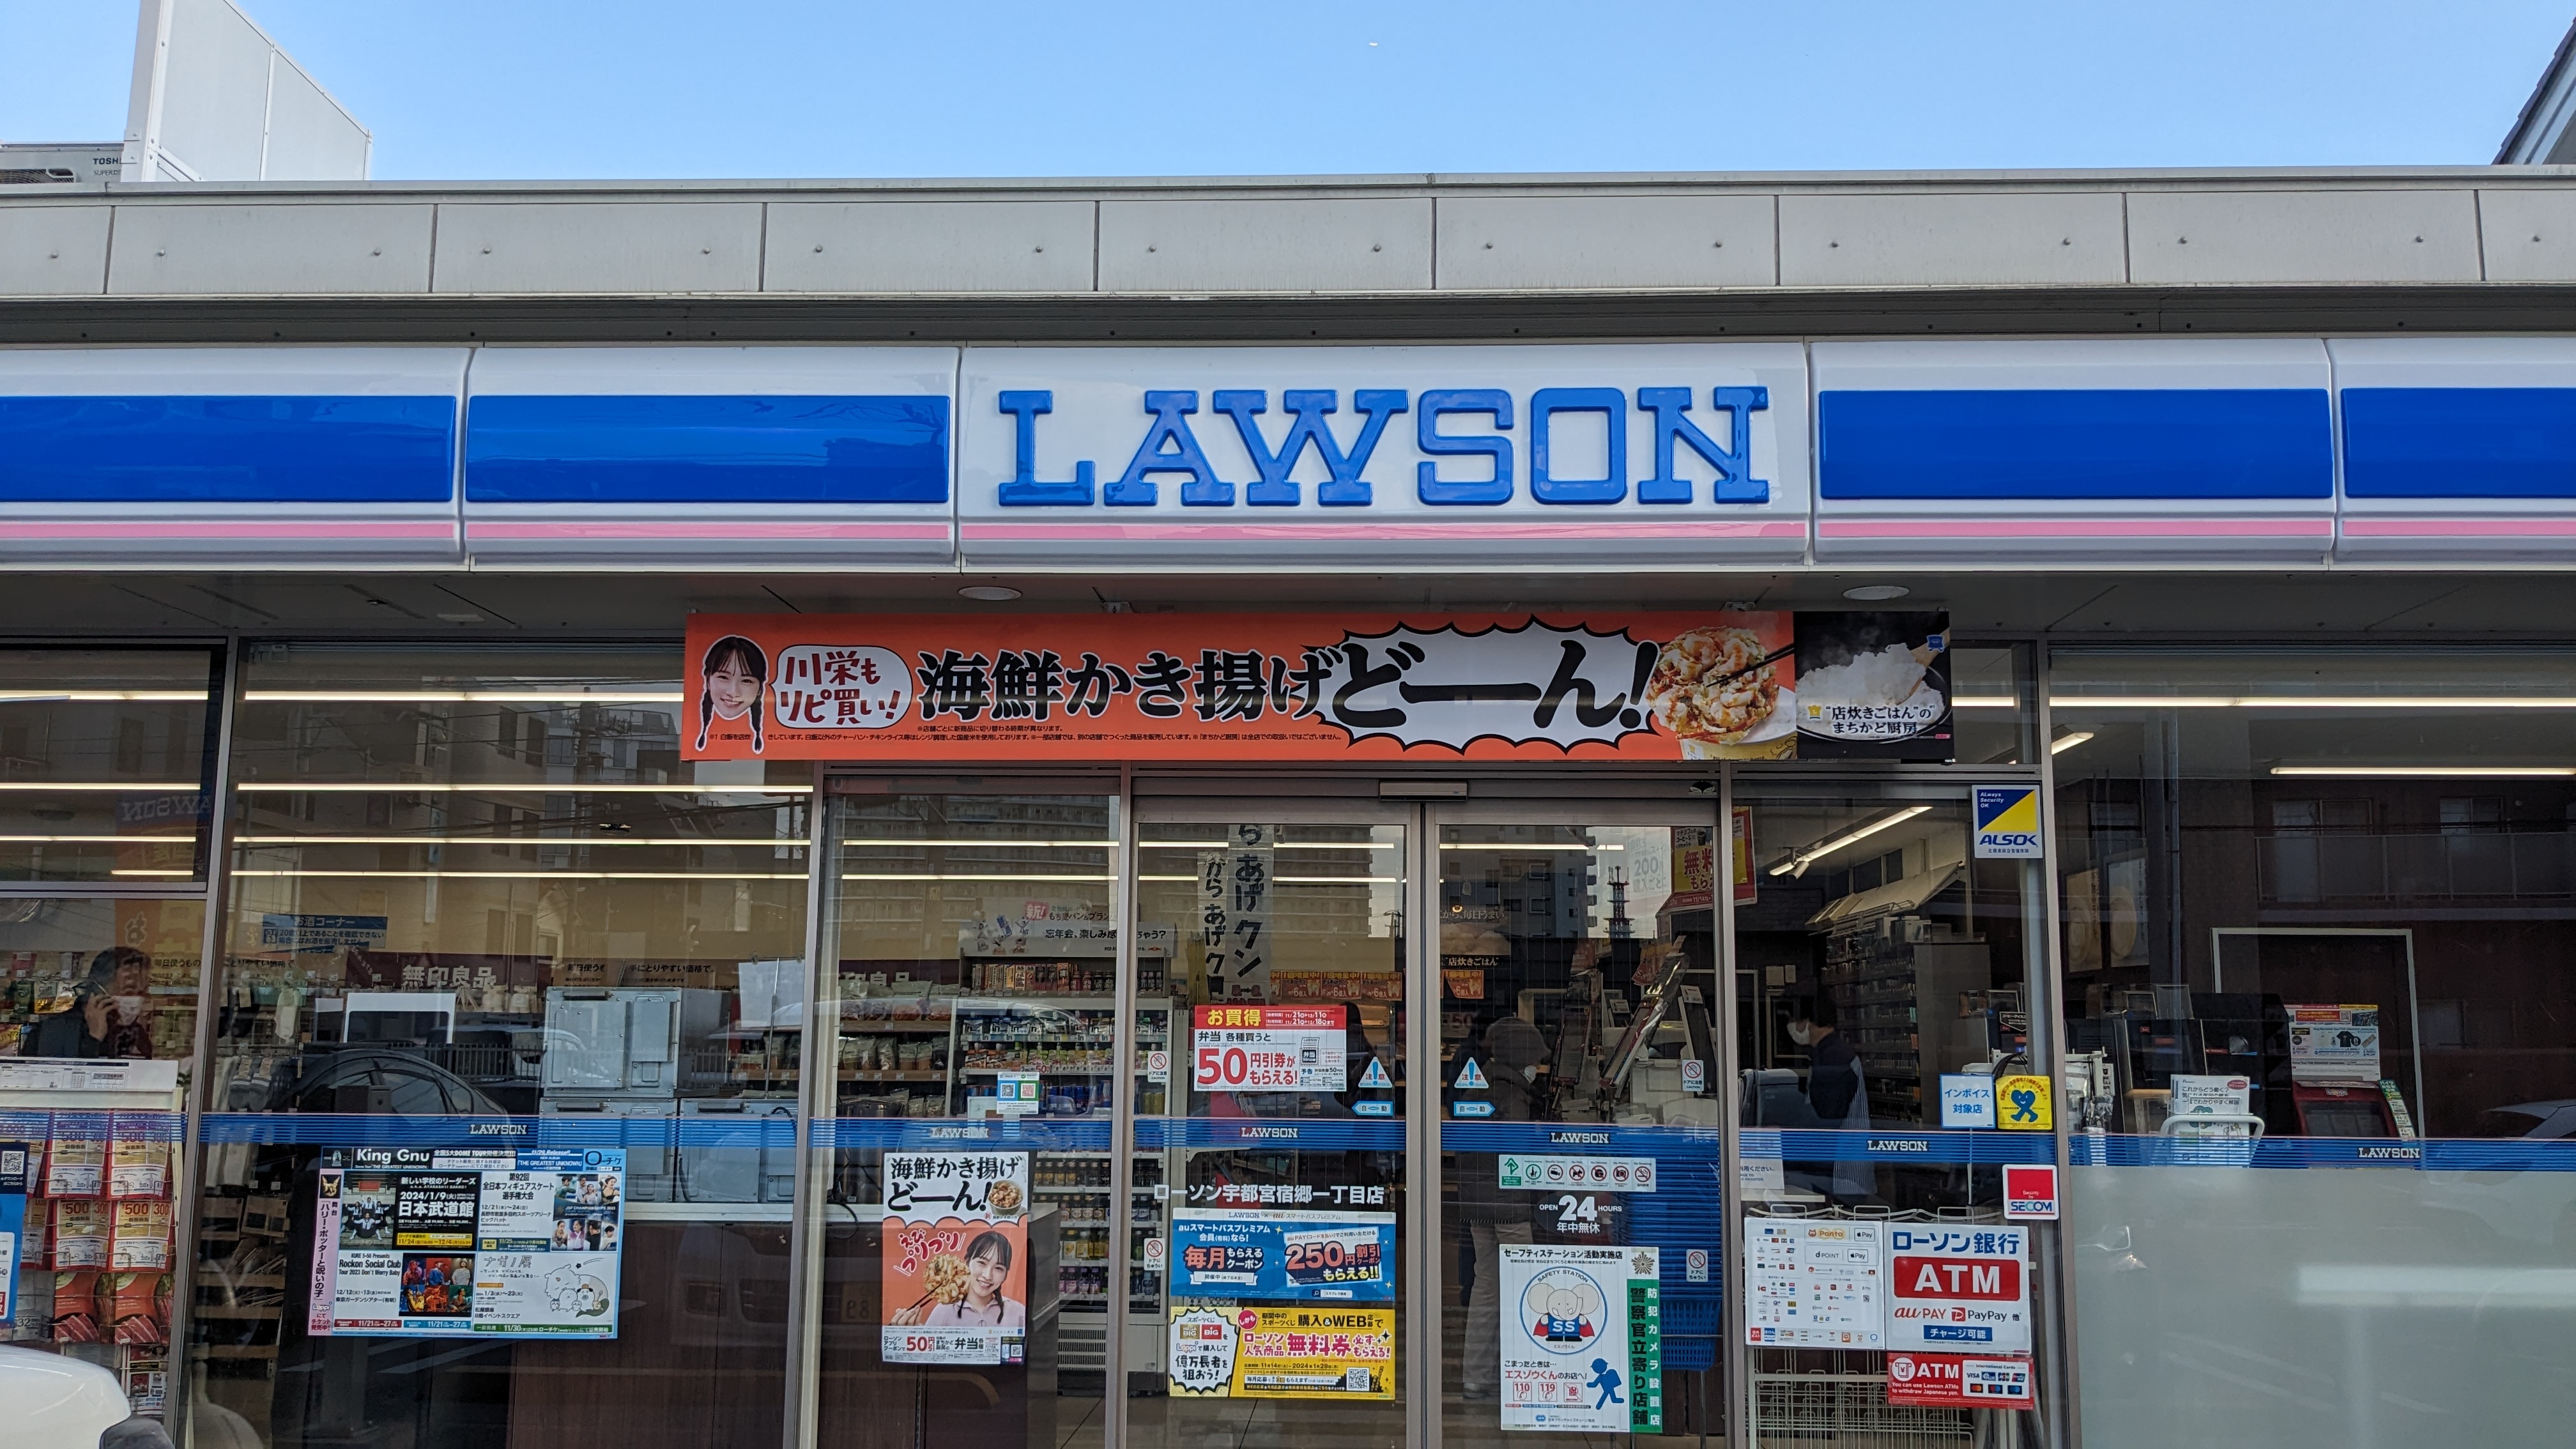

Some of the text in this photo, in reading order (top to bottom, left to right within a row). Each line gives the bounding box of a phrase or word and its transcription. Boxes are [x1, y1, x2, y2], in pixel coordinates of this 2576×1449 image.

[999, 387, 1770, 506] LAWSON
[785, 650, 881, 686] 川栄も
[916, 648, 1342, 723] 海鮮かき揚げ
[779, 687, 900, 725] リピ買い!
[1832, 721, 1917, 734] まちかど厨房
[1979, 834, 2038, 846] ALSOK
[295, 916, 355, 926] お酒コーナー
[402, 964, 496, 988] 無印良品
[1207, 1009, 1261, 1027] お買得
[1198, 1031, 1271, 1042] 弁当 各種買うと
[1197, 1047, 1248, 1085] 50
[1250, 1053, 1296, 1068] 円引券が
[1250, 1070, 1298, 1085] もらえる!
[1944, 1088, 1990, 1098] インボイス
[1952, 1103, 1982, 1114] 対象店
[470, 1124, 528, 1135] LAWSON
[931, 1128, 989, 1138] LAWSON
[1241, 1128, 1299, 1138] LAWSON
[1551, 1132, 1610, 1144] LAWSON
[1867, 1140, 1928, 1151] LAWSON
[356, 1149, 430, 1164] King Gnu
[2358, 1147, 2421, 1159] LAWSON
[890, 1156, 1020, 1181] 海鮮かき揚げ
[401, 1177, 477, 1185] 新しい学校のリーダーズ
[482, 1182, 555, 1191] 全日本フィギュアスケート
[502, 1192, 534, 1200] 選手権大会
[1153, 1184, 1384, 1205] ローソン宇都宮宿郷一丁目店
[65, 1202, 89, 1215] 500
[125, 1203, 149, 1215] 500
[153, 1204, 169, 1216] 300
[399, 1201, 475, 1217] 日本武道館
[1558, 1194, 1597, 1222] 24
[2011, 1200, 2053, 1212] SECOM
[1178, 1223, 1271, 1233] auスマートパスプレミアム
[1556, 1222, 1600, 1234] 年中無休
[1892, 1231, 2020, 1255] ローソン銀行
[1227, 1248, 1263, 1258] もらえる
[1285, 1241, 1344, 1271] 250
[1356, 1244, 1381, 1258] 割引
[1504, 1248, 1623, 1260] セーフティステーション活動実施店
[339, 1259, 401, 1268] Rockon Social Club
[1184, 1246, 1225, 1269] 毎月
[1345, 1255, 1355, 1266] 円
[1226, 1259, 1263, 1269] クーポン
[1537, 1269, 1589, 1283] SAFETY STATION
[1913, 1263, 2000, 1294] ATM
[1239, 1315, 1256, 1326] しかも
[1894, 1307, 1921, 1319] au
[1922, 1308, 1947, 1319] PAY
[1968, 1310, 2007, 1322] PayPay
[1204, 1326, 1219, 1335] BIG
[1929, 1328, 1986, 1339] チャージ可能
[906, 1336, 928, 1351] 50
[954, 1337, 979, 1350] 弁当
[1243, 1333, 1284, 1344] ローソン
[1286, 1332, 1352, 1357] 無料券
[1244, 1344, 1284, 1356] 人気商品
[1630, 1287, 1648, 1425] 警察官立寄り店舗
[1175, 1355, 1228, 1368] 億万長者を
[1647, 1287, 1660, 1426] 防犯カメラ設置店
[1183, 1369, 1220, 1381] 狙おう!
[1917, 1362, 1959, 1379] ATM
[1514, 1383, 1556, 1392] 110 119
